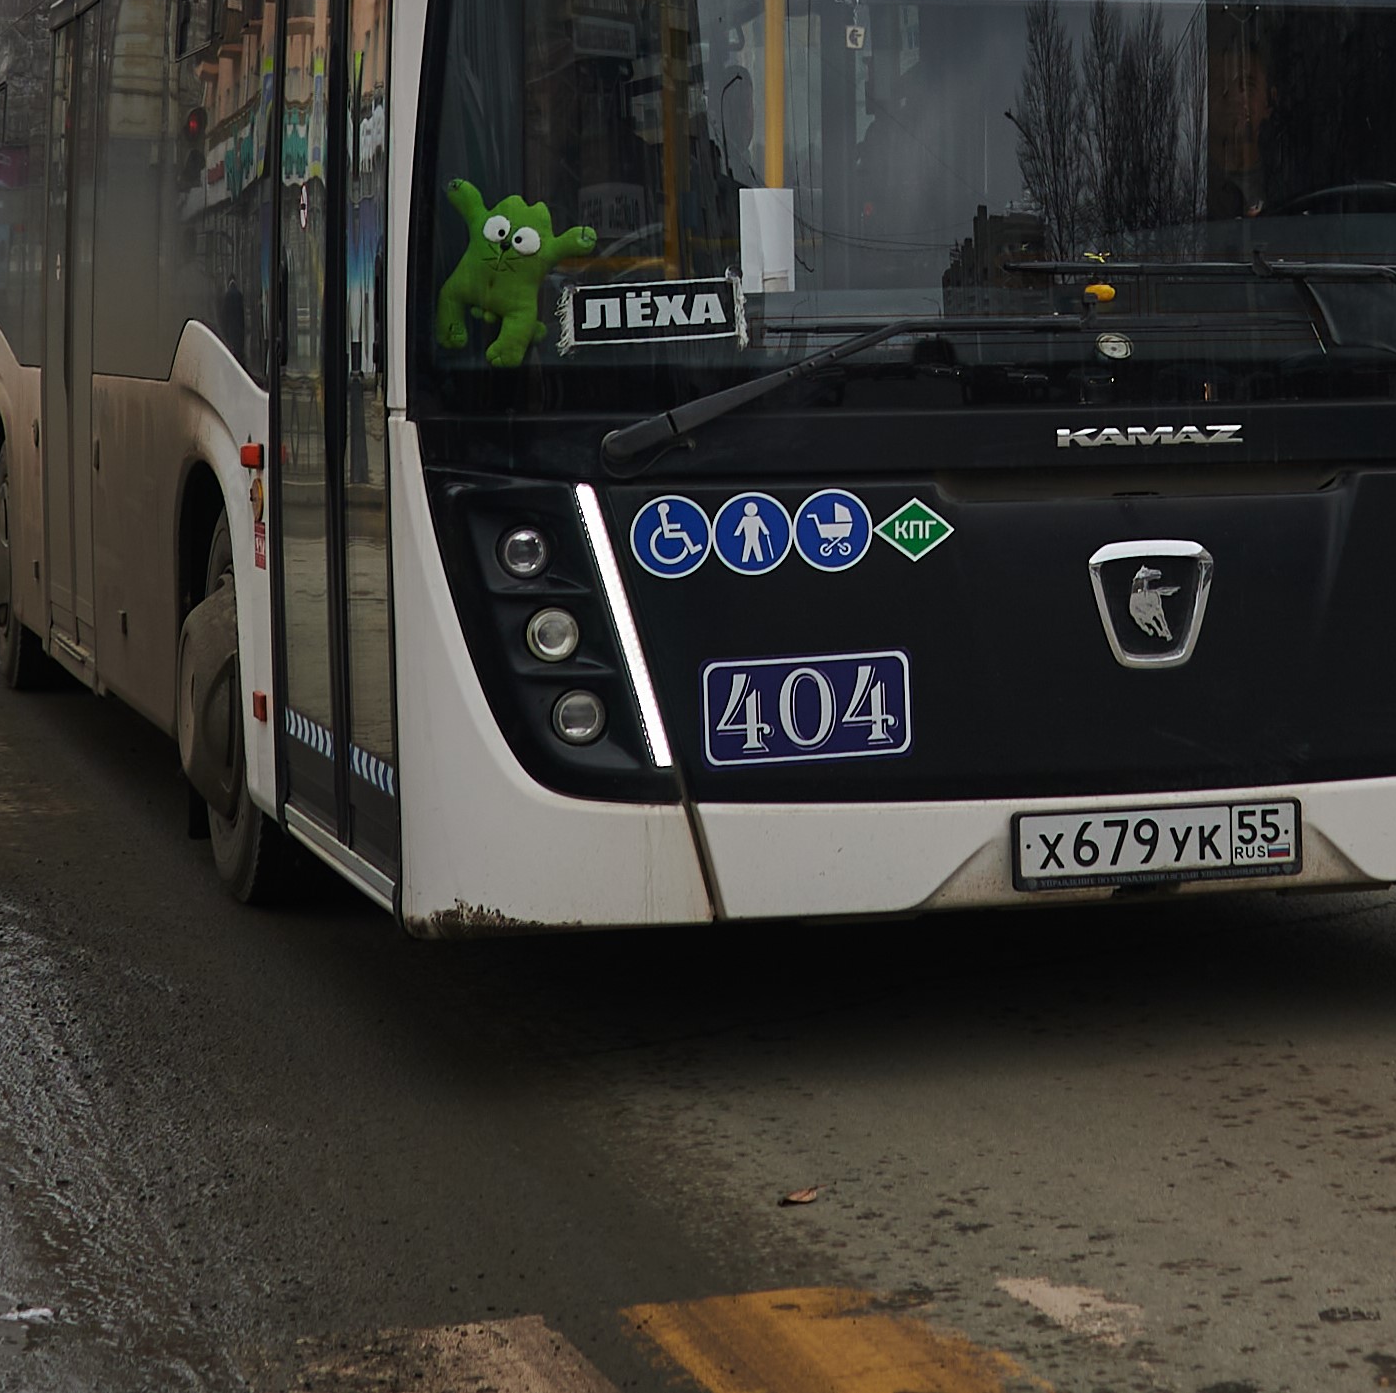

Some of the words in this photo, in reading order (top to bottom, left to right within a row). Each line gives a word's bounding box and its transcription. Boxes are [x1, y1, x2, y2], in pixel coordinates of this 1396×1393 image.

[581, 291, 727, 330] ЛЁХА
[1056, 424, 1244, 448] KAMAZ
[895, 519, 937, 540] КПГ
[716, 665, 898, 754] 404
[1038, 817, 1223, 871] Х679УК
[1237, 808, 1281, 846] 55
[1234, 844, 1267, 860] RUS
